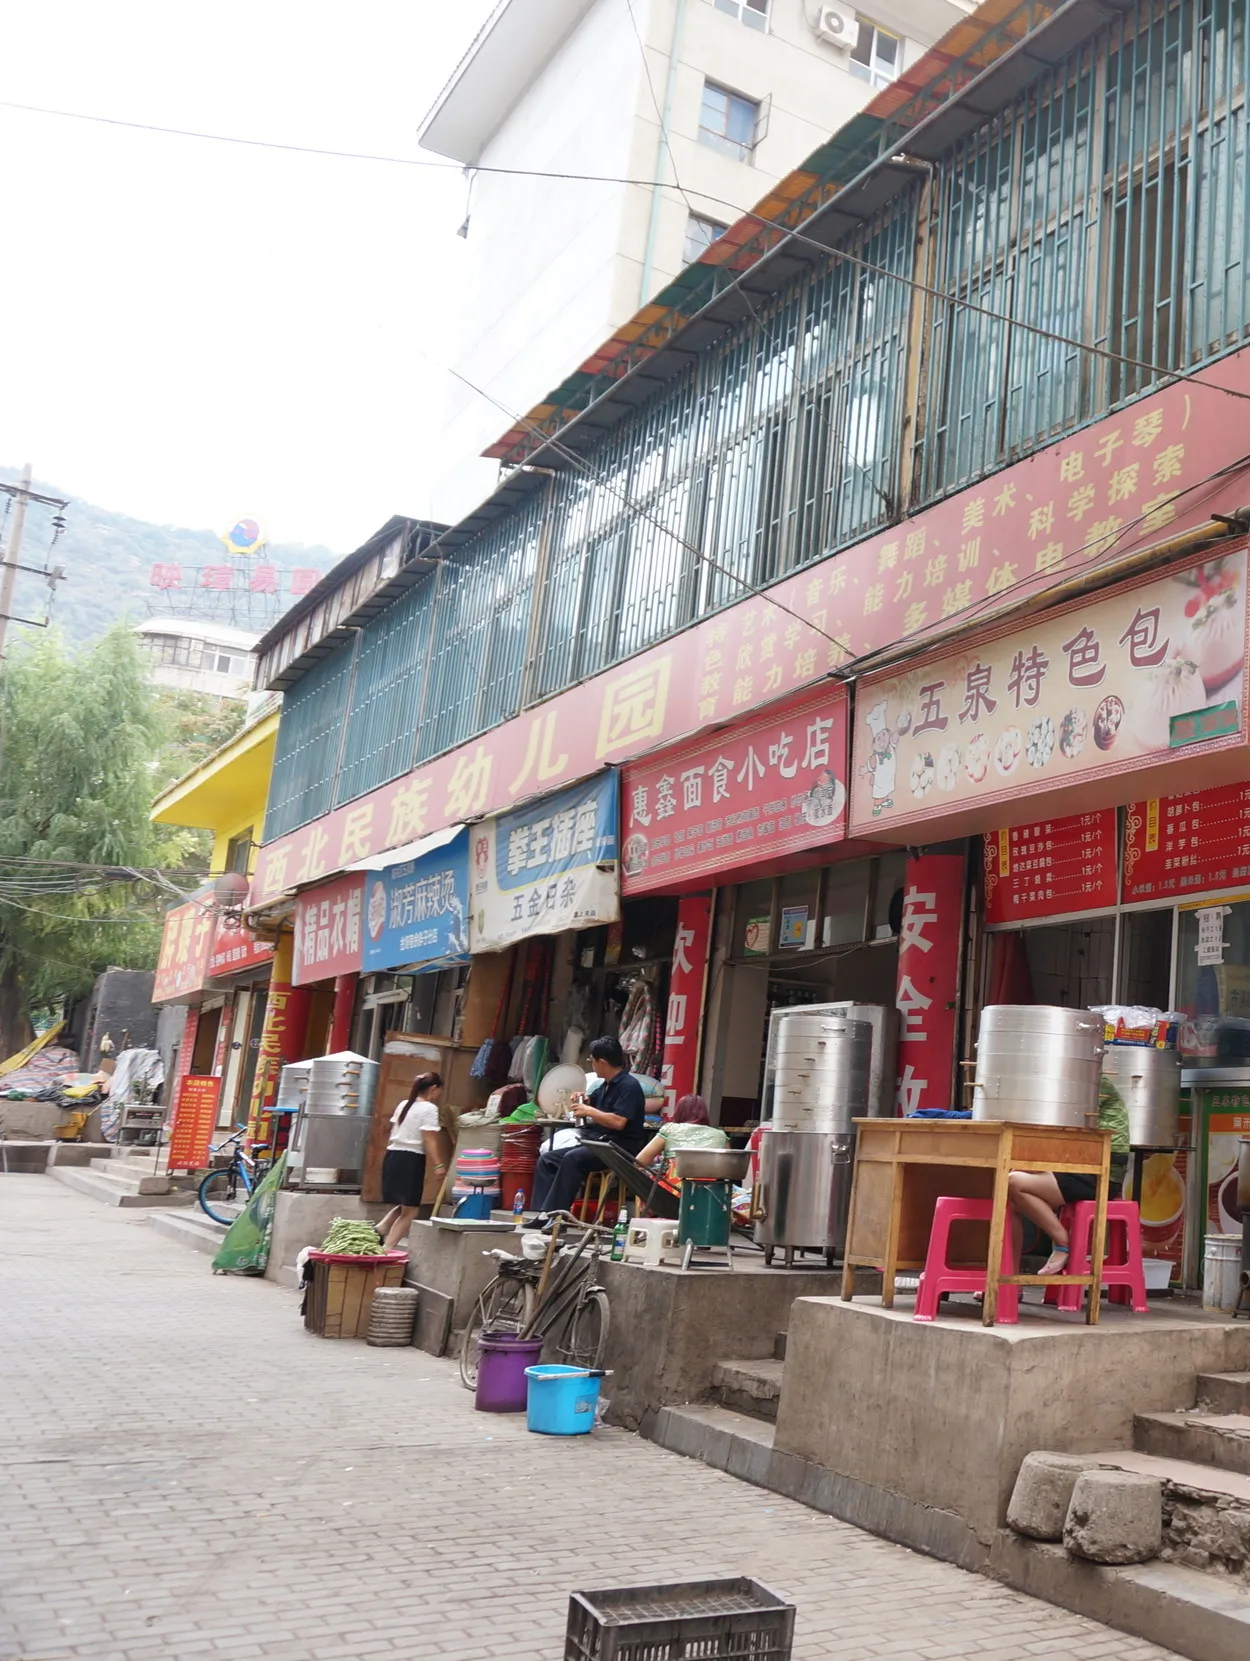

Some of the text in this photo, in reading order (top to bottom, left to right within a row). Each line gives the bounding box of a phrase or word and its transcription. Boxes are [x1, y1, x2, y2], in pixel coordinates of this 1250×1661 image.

[697, 622, 728, 720] 特色教育
[912, 606, 1170, 739] 五泉特色包
[262, 655, 672, 893] 西北民族幼儿园
[303, 886, 361, 966] 精品衣帽
